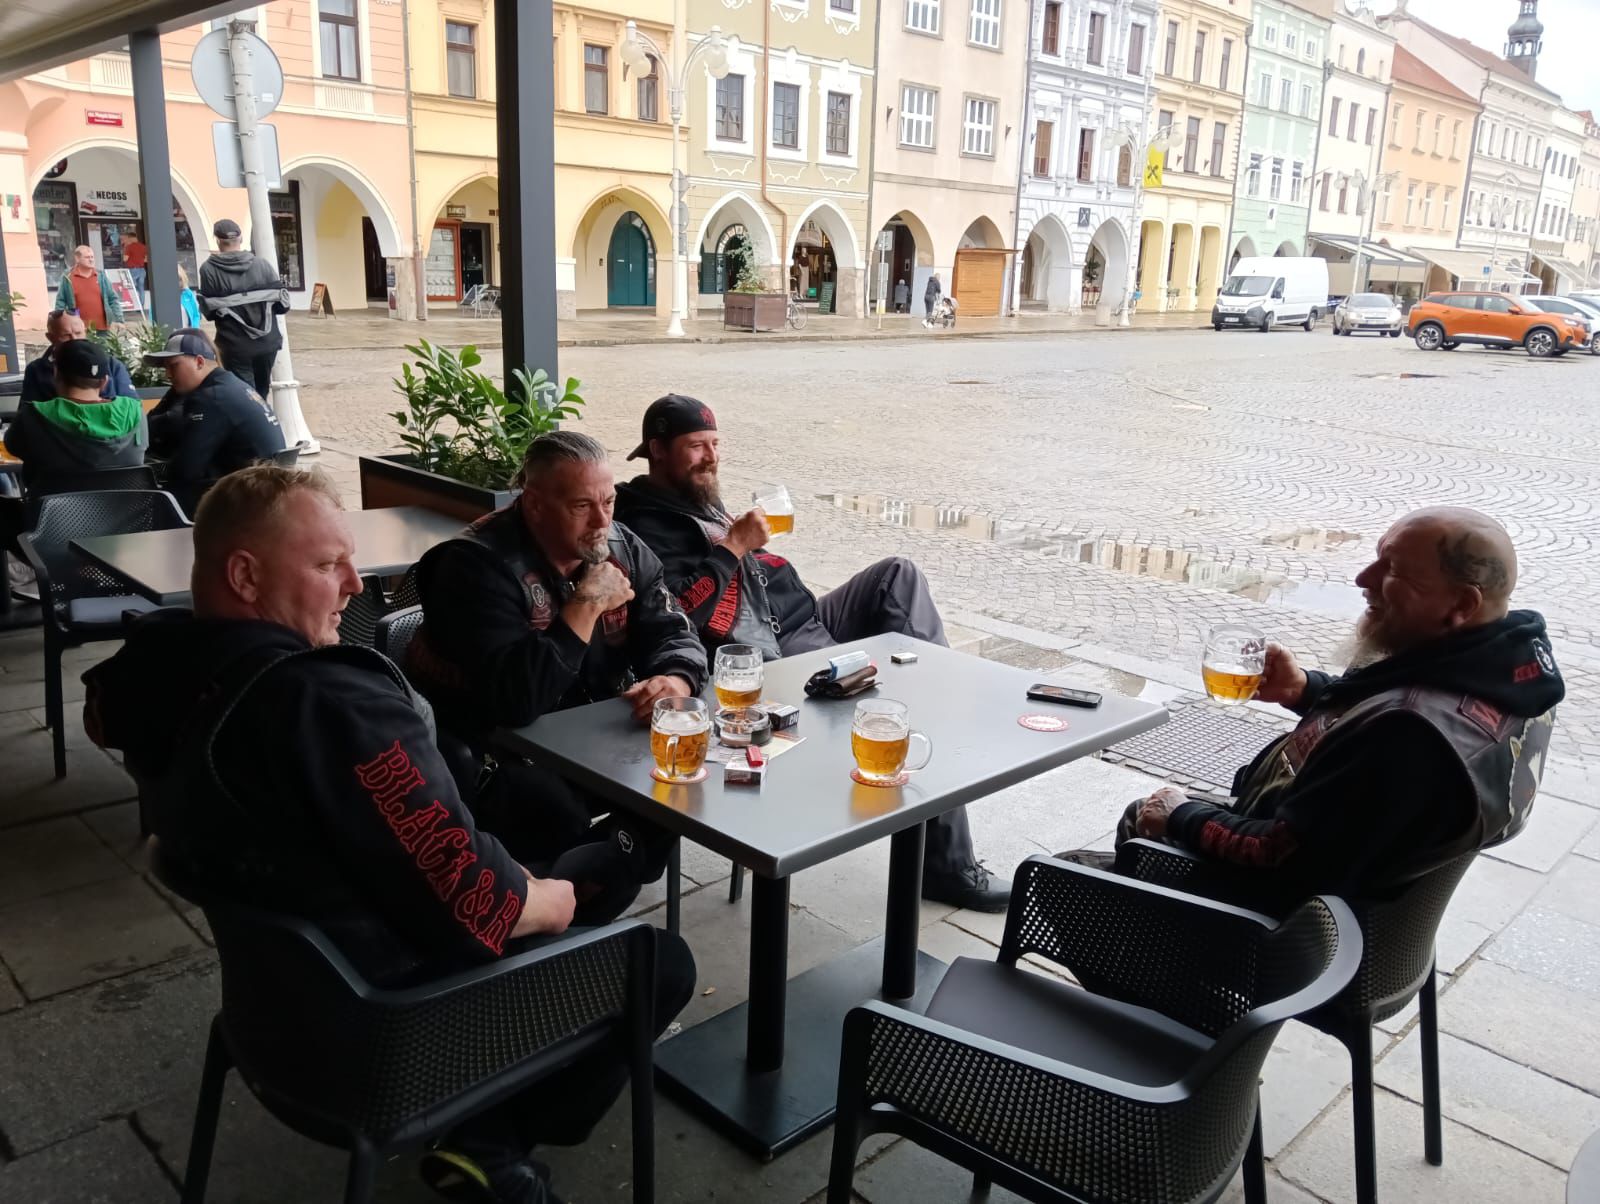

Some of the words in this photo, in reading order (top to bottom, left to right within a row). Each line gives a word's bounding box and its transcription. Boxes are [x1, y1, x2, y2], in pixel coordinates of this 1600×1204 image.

[96, 191, 128, 201] NECOSS
[354, 739, 478, 903] BLACK
[454, 868, 496, 934] &
